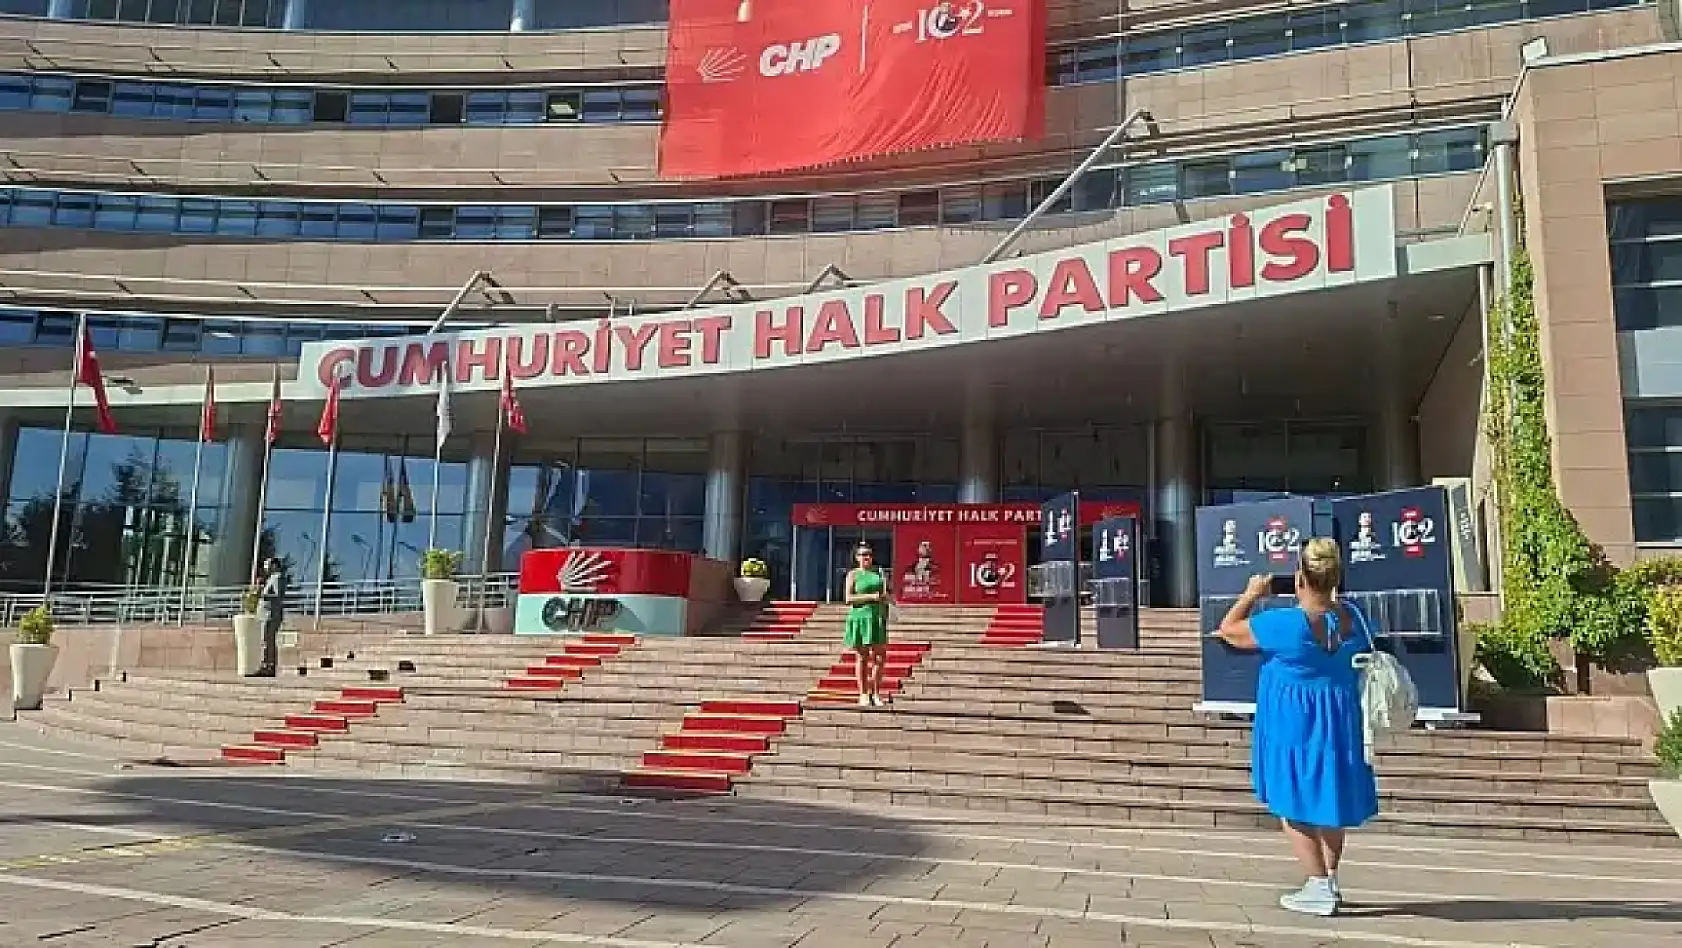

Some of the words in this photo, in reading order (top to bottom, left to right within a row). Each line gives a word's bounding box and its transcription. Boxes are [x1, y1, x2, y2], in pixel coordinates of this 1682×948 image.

[759, 33, 840, 76] CHP
[317, 316, 732, 388] CUMHURİYET
[754, 280, 960, 358] HALK
[987, 194, 1356, 329] PARTİSİ
[857, 506, 954, 522] CUMHURİYET
[958, 509, 1000, 522] HALK
[542, 597, 622, 631] CHP
